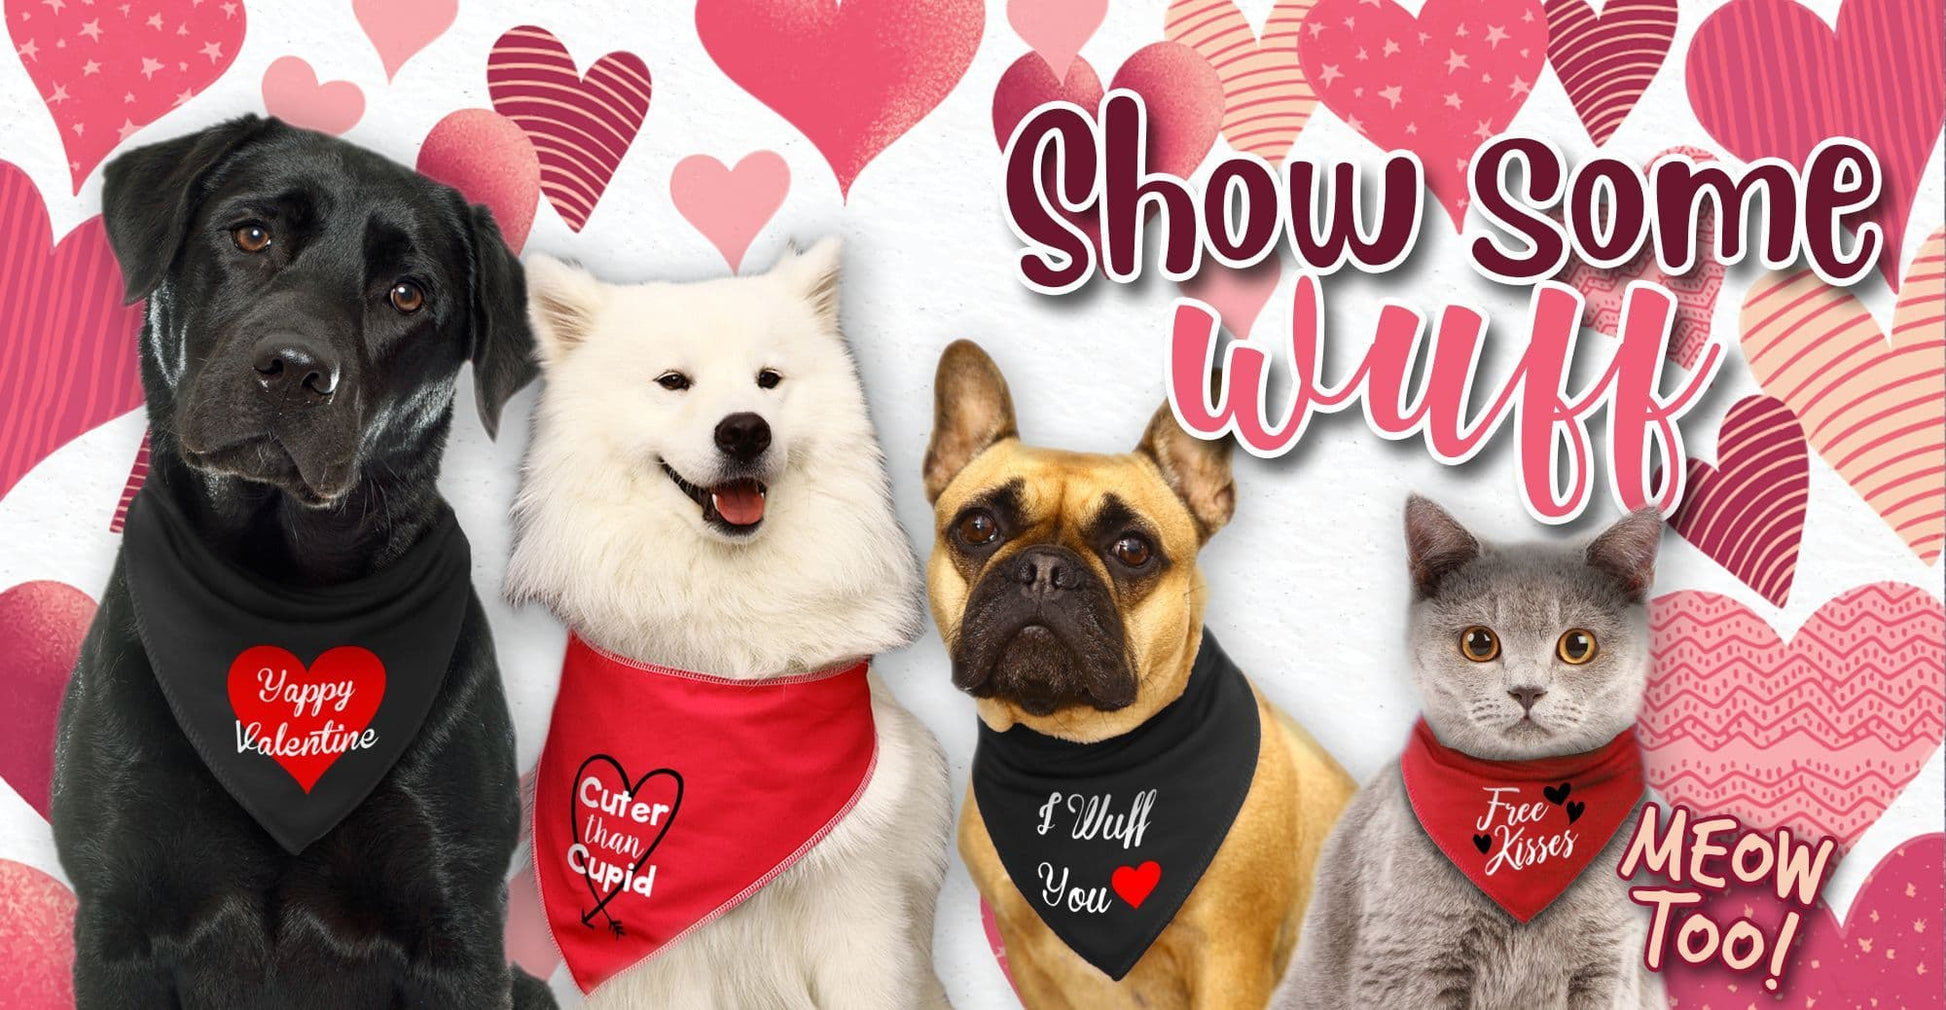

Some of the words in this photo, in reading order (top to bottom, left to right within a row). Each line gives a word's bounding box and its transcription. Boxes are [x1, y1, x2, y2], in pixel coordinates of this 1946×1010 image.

[256, 667, 356, 718] Yappy
[235, 719, 380, 757] Valentine
[579, 776, 670, 826] Cuter
[1037, 792, 1063, 836] I
[1066, 788, 1158, 850] Wuff
[1476, 786, 1550, 832] Free
[584, 813, 645, 860] than
[1484, 824, 1580, 877] Kisses
[566, 842, 658, 898] Cupid
[1037, 861, 1113, 914] You
